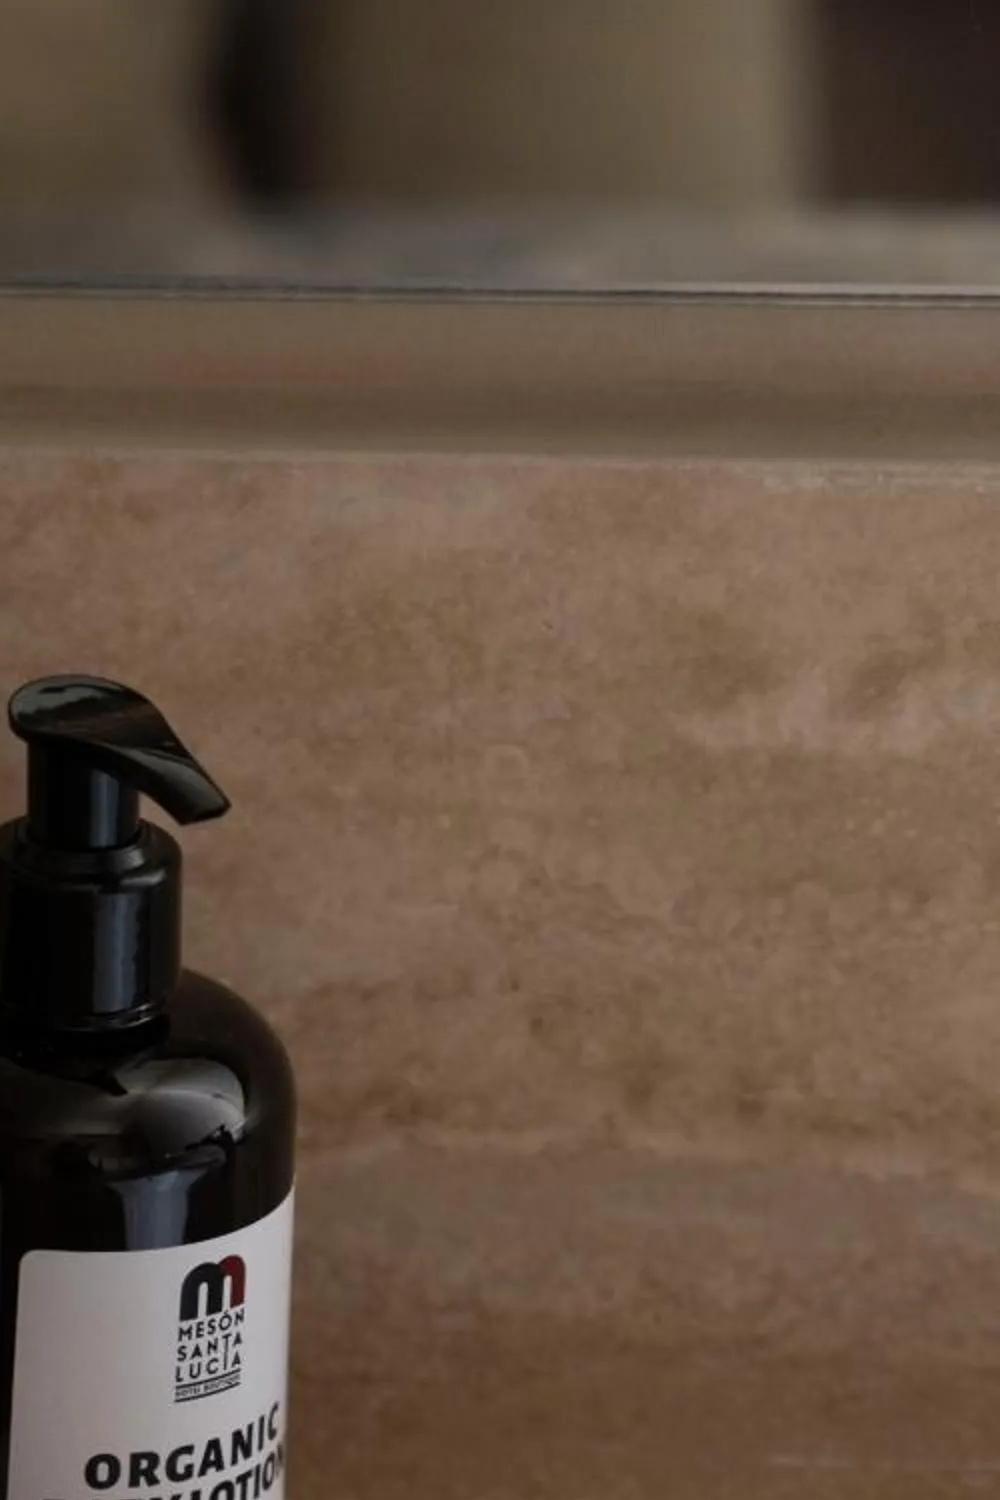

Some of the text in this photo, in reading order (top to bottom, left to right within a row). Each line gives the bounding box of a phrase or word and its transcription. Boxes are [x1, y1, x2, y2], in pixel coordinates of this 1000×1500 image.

[178, 1307, 244, 1342] MESÓN
[176, 1332, 242, 1362] SANTA
[85, 1401, 279, 1491] ORGANIC
